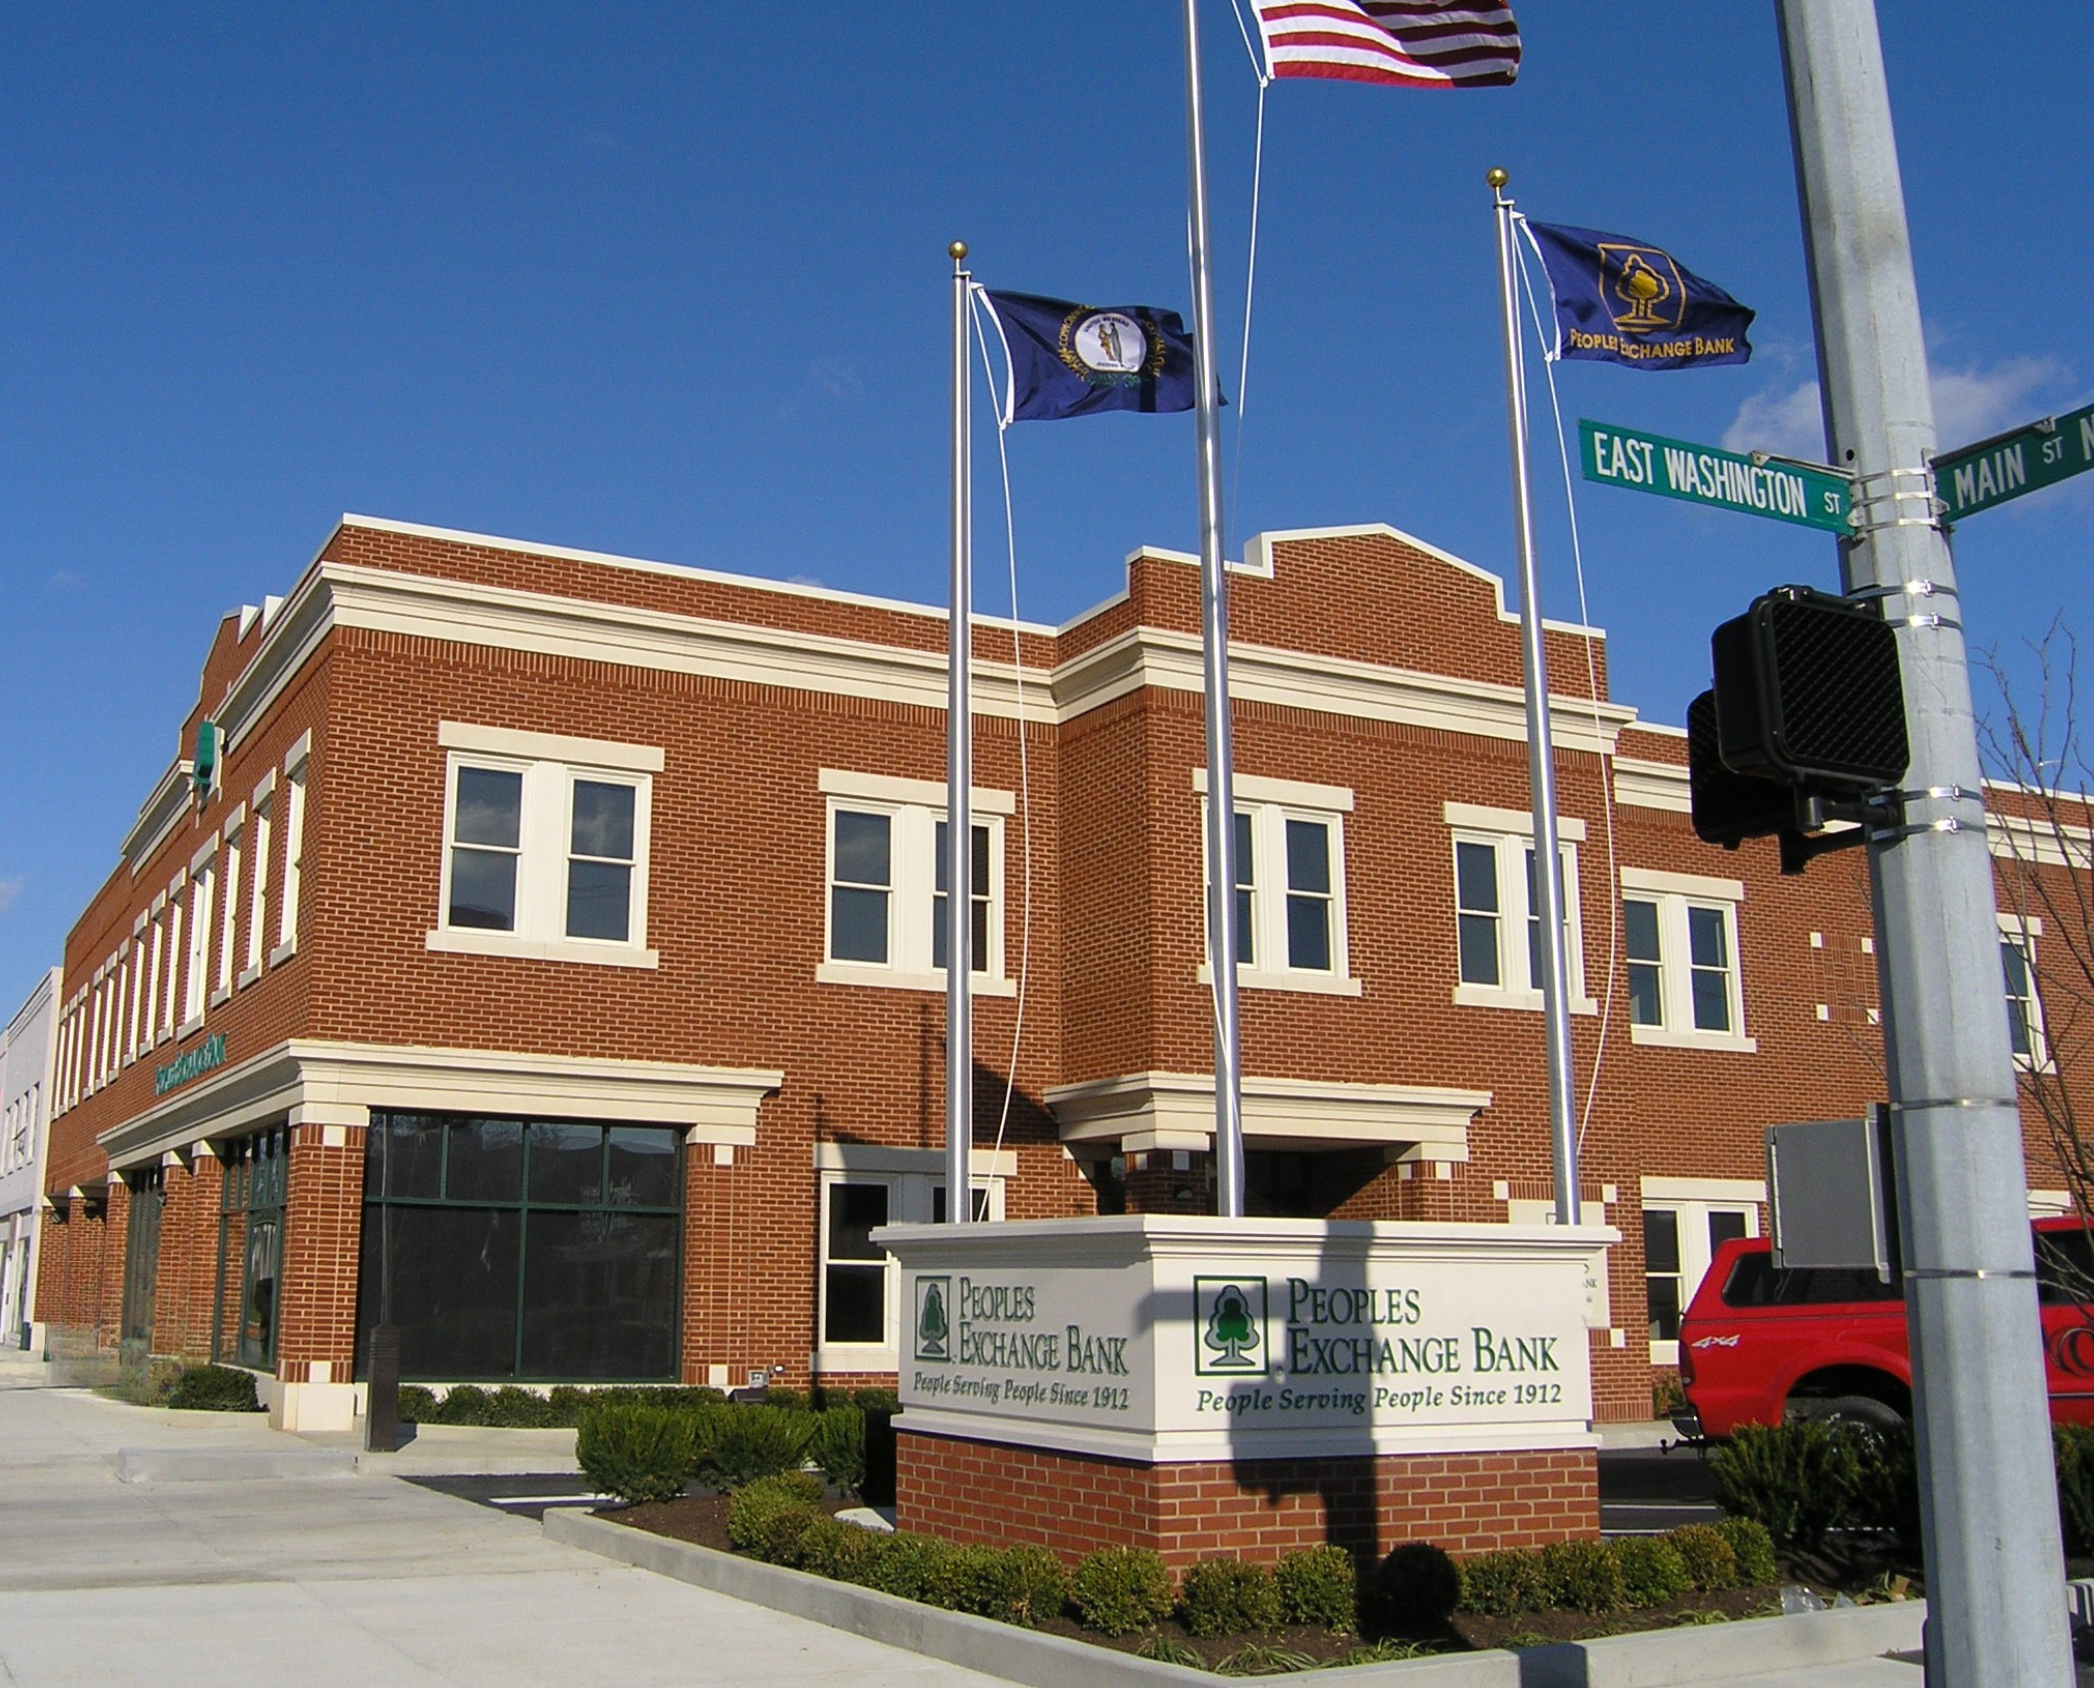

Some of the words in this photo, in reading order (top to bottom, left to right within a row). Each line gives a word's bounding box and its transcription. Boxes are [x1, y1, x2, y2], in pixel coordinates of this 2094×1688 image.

[1569, 328, 1618, 352] PEOPLE
[1620, 338, 1692, 360] ECHANGE
[1695, 337, 1735, 355] BANK
[1593, 431, 1654, 485] EAST
[1664, 447, 1807, 518] WASHINGTON
[1823, 491, 1841, 515] ST
[1954, 443, 2026, 510] MAIN
[2042, 436, 2063, 464] ST
[959, 1276, 1035, 1321] PEOPLES
[1286, 1277, 1422, 1325] PEOPLES
[959, 1322, 1061, 1370] EXCHANGE
[1066, 1325, 1130, 1376] BANK
[1286, 1327, 1461, 1375] EXCHANGE
[1471, 1327, 1560, 1373] BANK
[914, 1372, 951, 1397] People
[953, 1375, 1000, 1405] Serving
[1004, 1379, 1047, 1406] People
[1050, 1382, 1089, 1407] Since
[1092, 1386, 1130, 1411] 1912
[1196, 1388, 1273, 1416] People
[1279, 1387, 1366, 1416] Serving
[1374, 1386, 1444, 1413] People
[1450, 1385, 1507, 1406] Since
[1513, 1383, 1562, 1405] 1912
